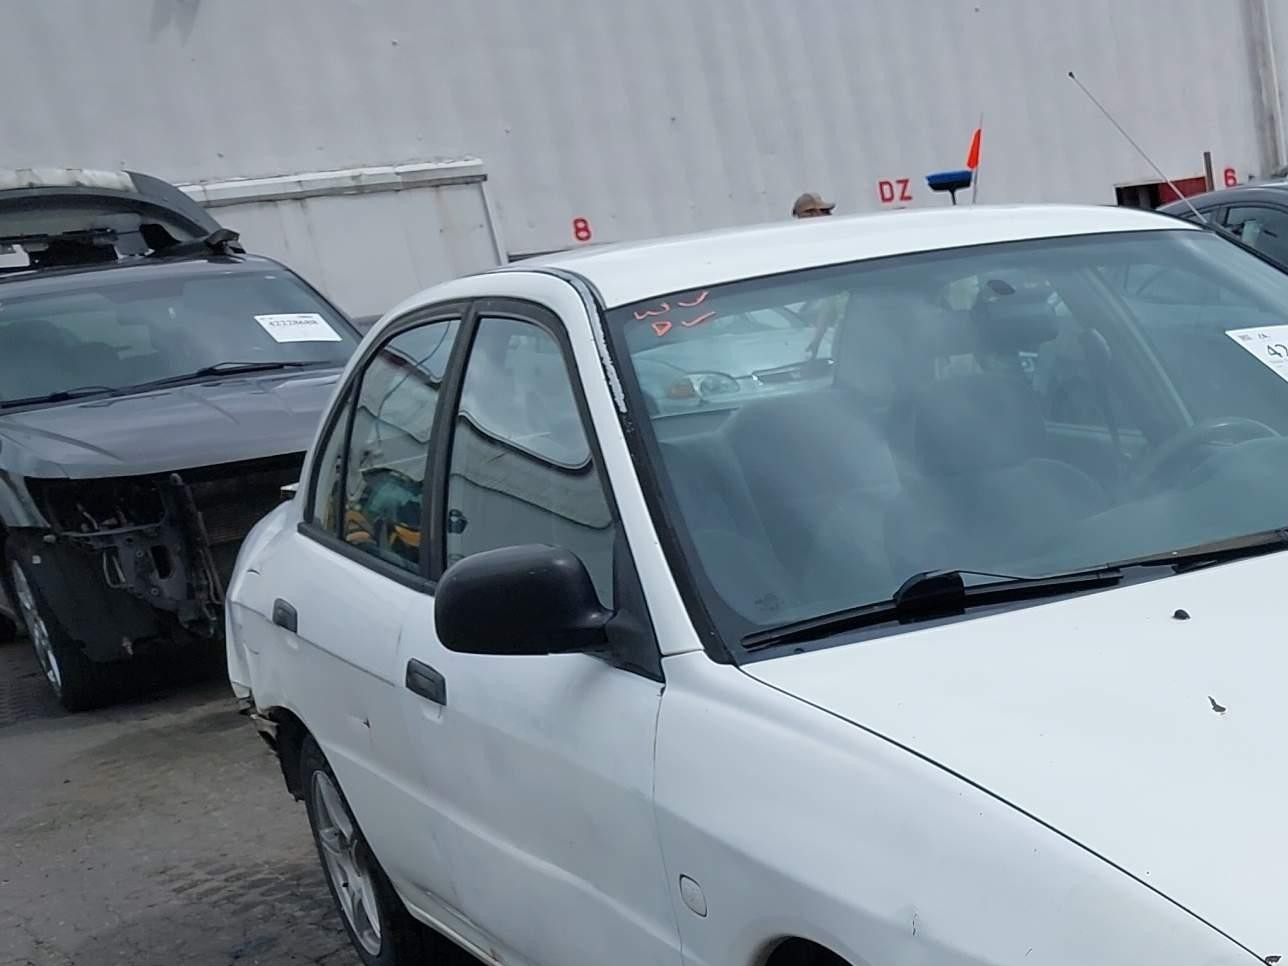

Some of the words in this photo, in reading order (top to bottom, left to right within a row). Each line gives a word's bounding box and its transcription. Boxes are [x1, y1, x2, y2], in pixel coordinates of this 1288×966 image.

[1223, 168, 1238, 188] 6
[878, 178, 913, 203] DZ
[573, 217, 591, 241] 8
